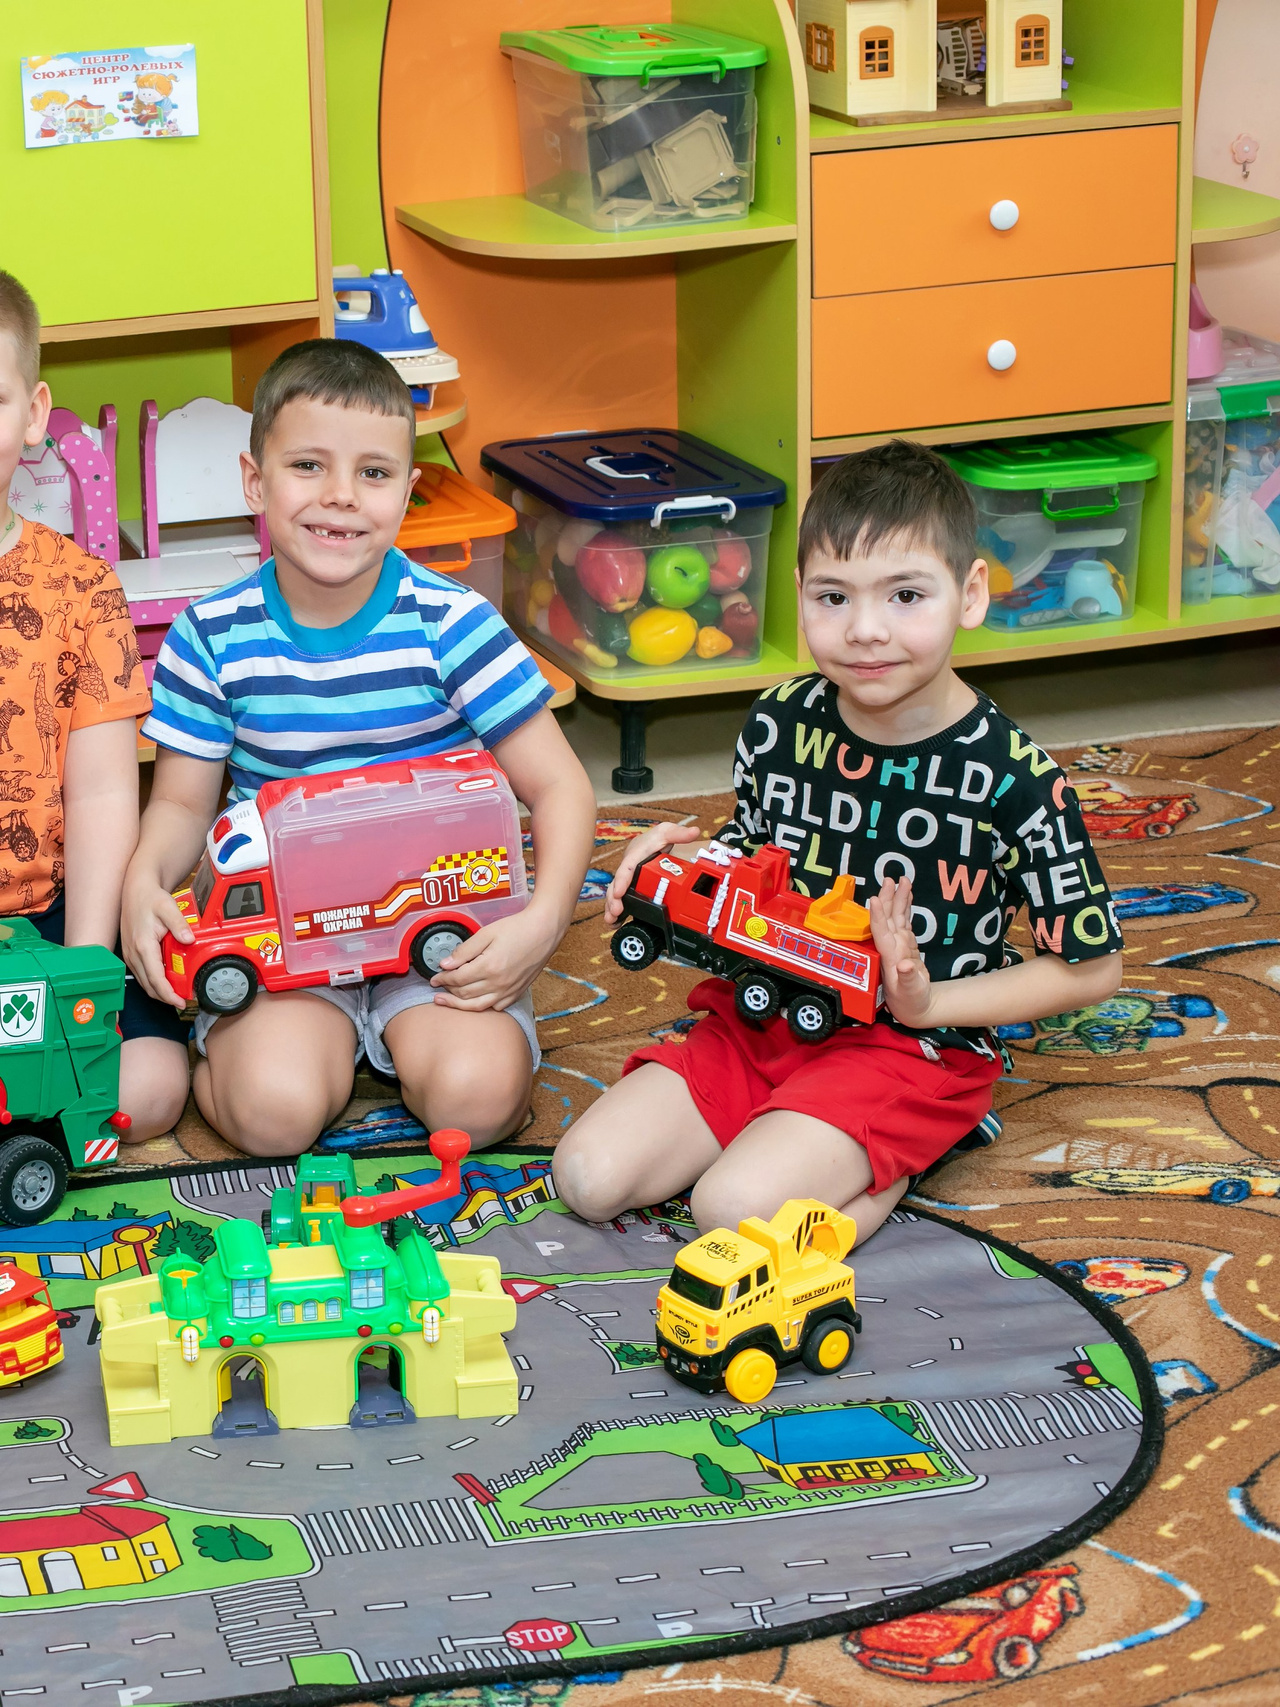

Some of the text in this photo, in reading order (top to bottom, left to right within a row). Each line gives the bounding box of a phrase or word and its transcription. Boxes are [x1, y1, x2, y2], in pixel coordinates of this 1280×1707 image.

[81, 54, 130, 65] ЦЕНТР
[32, 61, 184, 80] СЮЖЕТНО-РОЛЕВЫХ
[93, 76, 121, 85] ИГР
[423, 874, 459, 907] 01
[313, 904, 371, 924] ПОЖАРНАЯ
[322, 917, 364, 934] ОХРАНА
[535, 1241, 565, 1257] P
[792, 1287, 826, 1304] SUPER TOP
[505, 1625, 569, 1647] STOP
[657, 1623, 694, 1639] P
[117, 1685, 153, 1706] P
